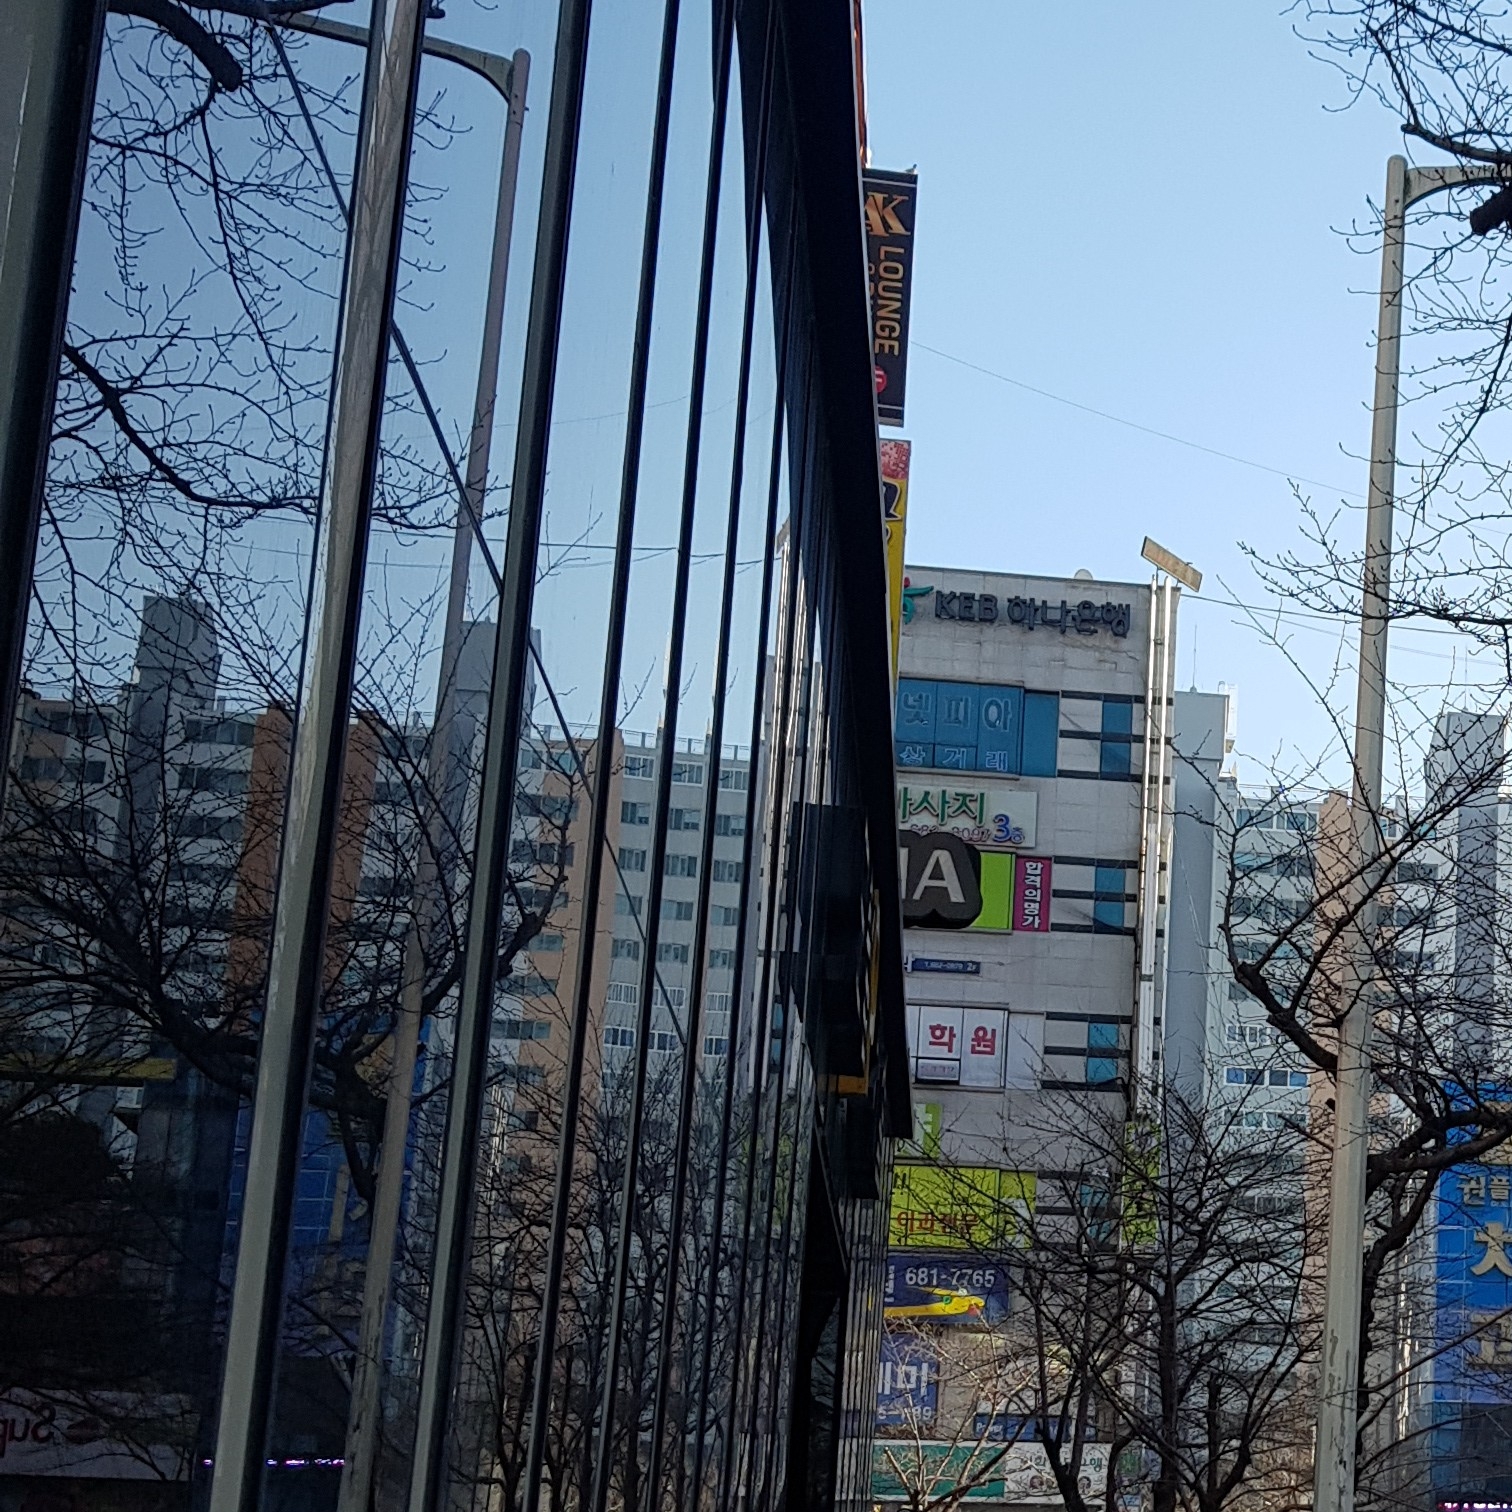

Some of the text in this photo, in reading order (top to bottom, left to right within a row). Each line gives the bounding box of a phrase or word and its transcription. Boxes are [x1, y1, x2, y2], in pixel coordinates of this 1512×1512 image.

[874, 245, 906, 357] LOUNGE
[935, 590, 1131, 639] KEB 하나은행
[929, 1023, 997, 1056] 학원
[905, 1267, 995, 1288] 681-7765
